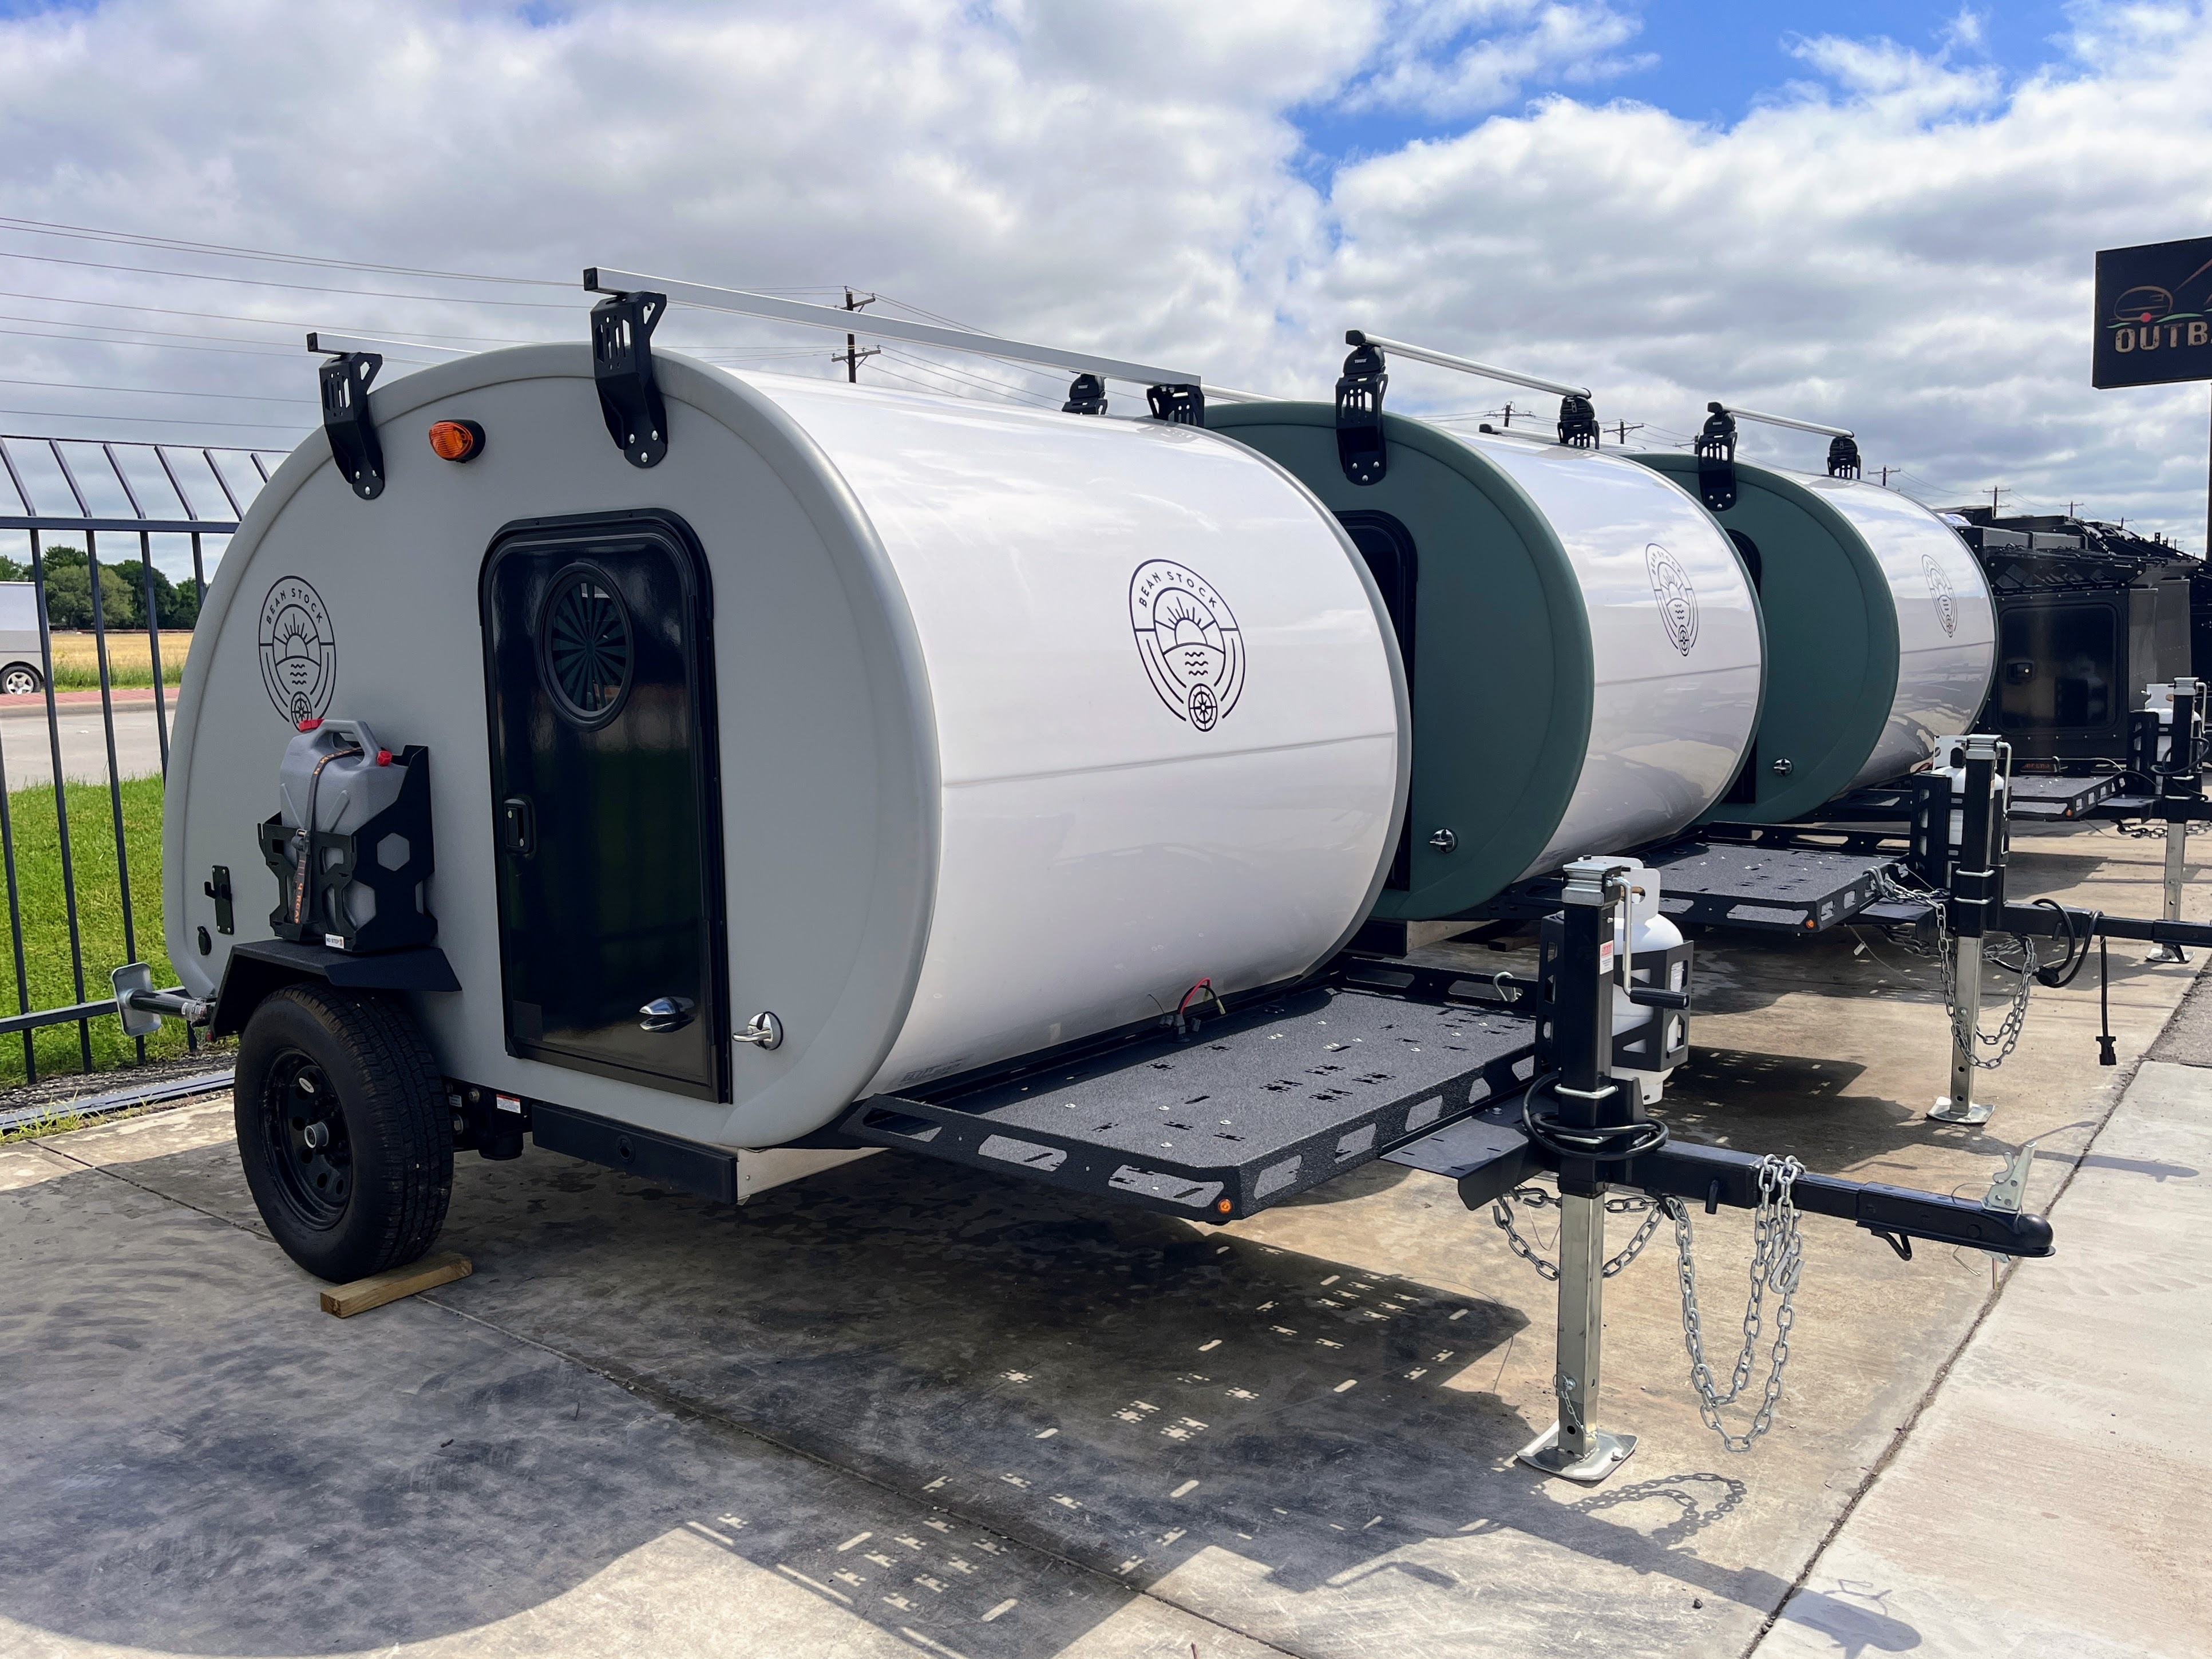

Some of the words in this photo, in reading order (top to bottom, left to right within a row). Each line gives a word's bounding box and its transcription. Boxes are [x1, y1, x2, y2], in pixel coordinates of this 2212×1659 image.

[2115, 320, 2212, 353] OUTB
[266, 590, 286, 624] BEAN
[291, 588, 323, 624] STOCK
[1139, 572, 1162, 608] BEAN
[1166, 571, 1217, 608] STOCK
